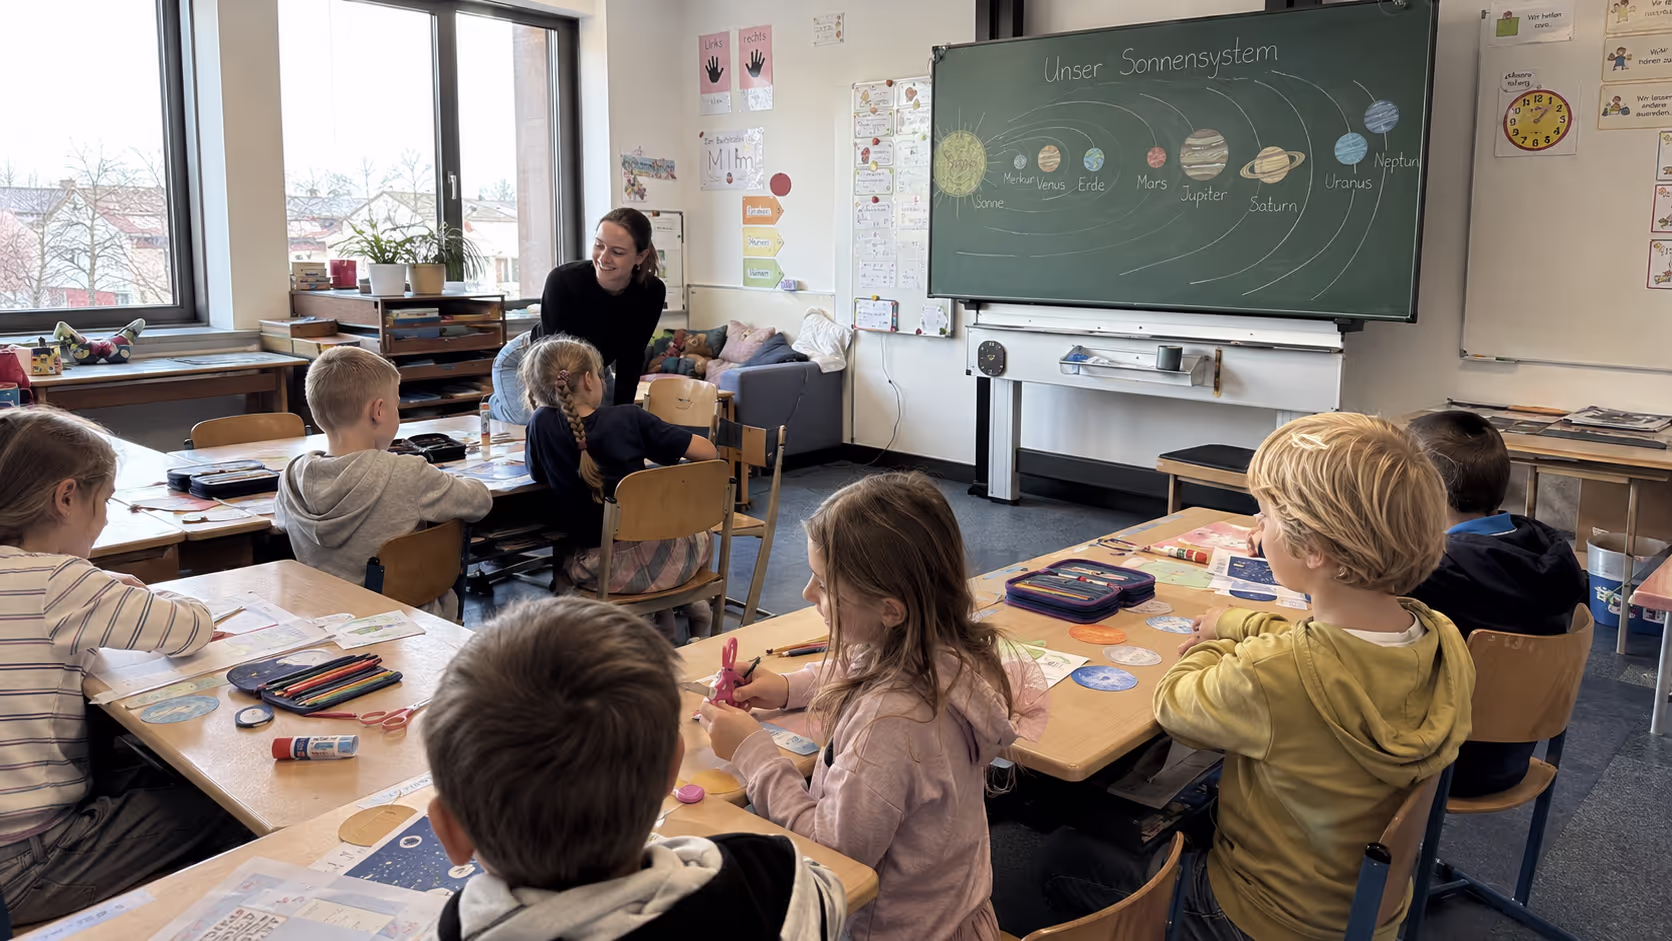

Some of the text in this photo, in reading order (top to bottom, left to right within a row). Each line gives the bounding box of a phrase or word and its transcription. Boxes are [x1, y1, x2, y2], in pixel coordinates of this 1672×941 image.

[743, 31, 767, 43] rechts
[1044, 37, 1278, 82] Unser Sonnensystem
[1534, 94, 1543, 103] 12
[1548, 96, 1553, 105] 1
[1556, 104, 1563, 113] 2
[1520, 136, 1528, 144] 7
[1532, 138, 1539, 147] 6
[1374, 152, 1420, 173] Neptun
[1003, 172, 1035, 185] Merkur
[1036, 175, 1066, 190] Venus
[1078, 176, 1105, 191] Erde
[1137, 174, 1168, 190] Mars
[1325, 173, 1373, 190] Uranus
[976, 194, 1004, 209] Sonne
[1180, 185, 1227, 208] Jupiter
[1249, 195, 1298, 213] Saturn
